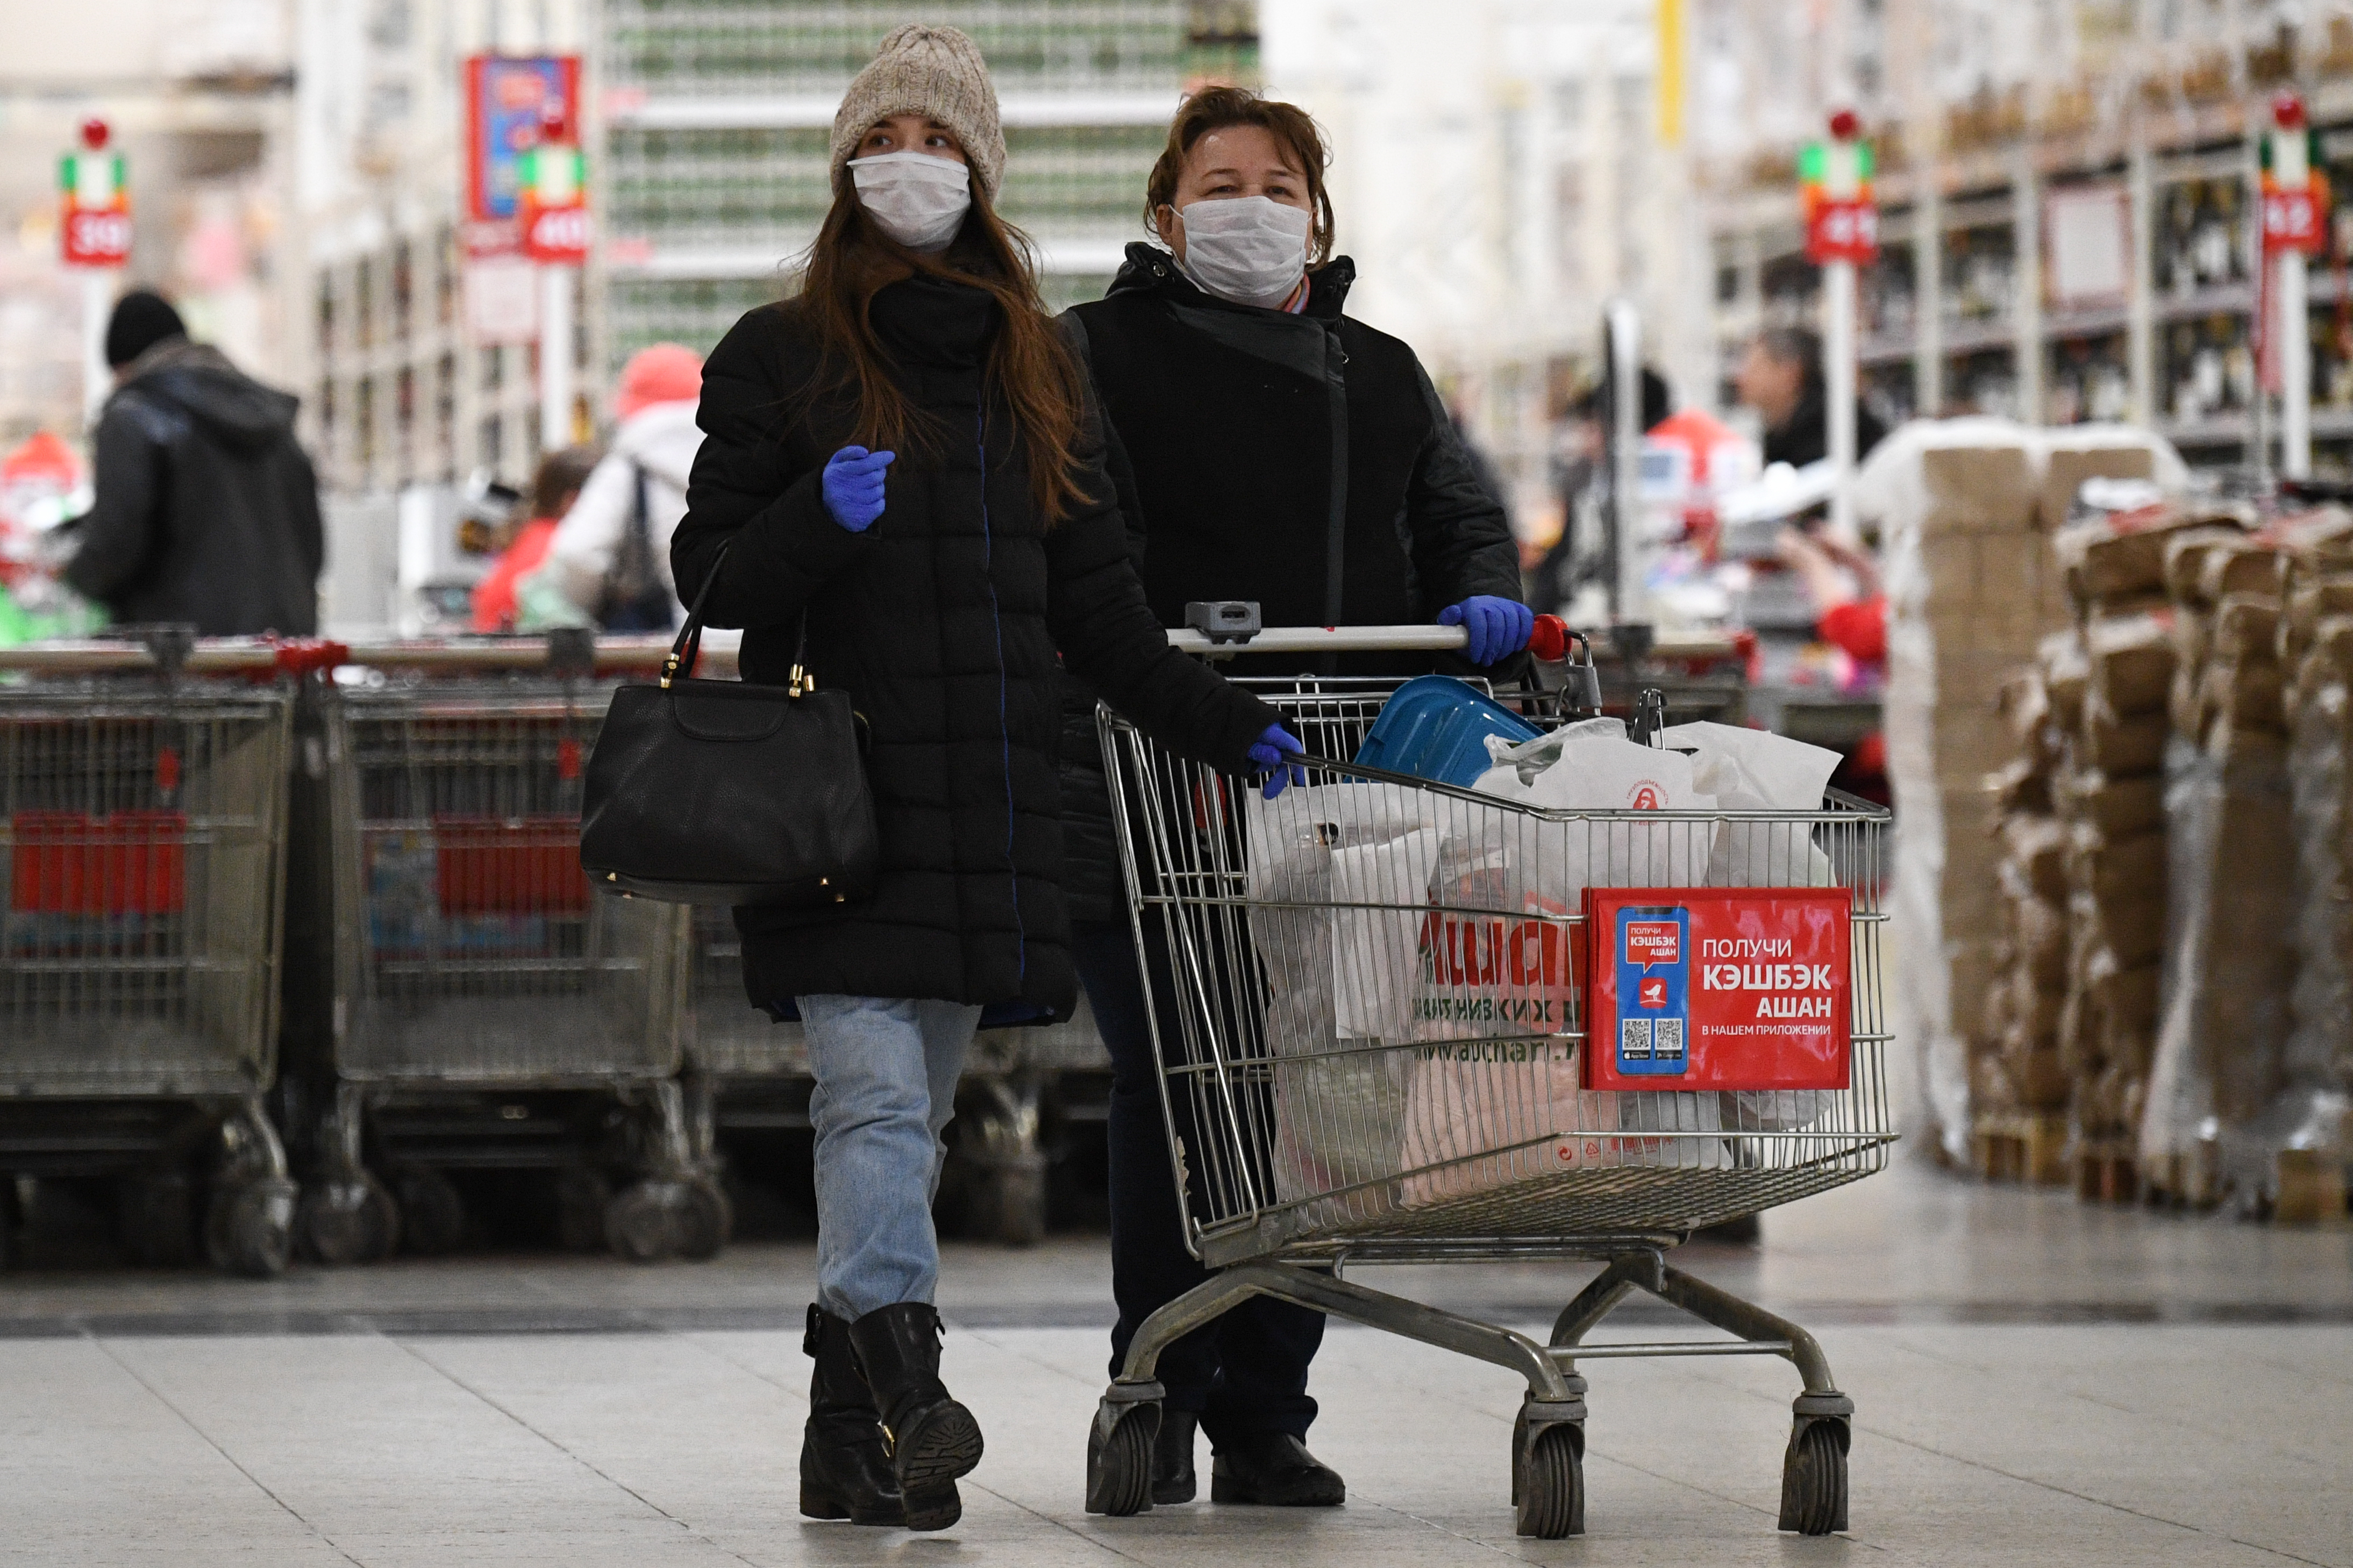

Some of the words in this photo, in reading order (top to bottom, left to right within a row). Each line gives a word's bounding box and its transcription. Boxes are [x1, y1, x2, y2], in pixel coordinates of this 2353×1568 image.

[1631, 936, 1676, 946] КЭШБЭК
[1703, 939, 1792, 957] ПОЛУЧИ
[1650, 948, 1676, 956] АШАН
[1703, 964, 1831, 991] КЭШБЭК
[1756, 997, 1831, 1018] АШАН
[1702, 1025, 1709, 1035] В
[1712, 1025, 1754, 1035] НАШЕМ
[1756, 1025, 1831, 1035] ПРИЛОЖЕНИИ
